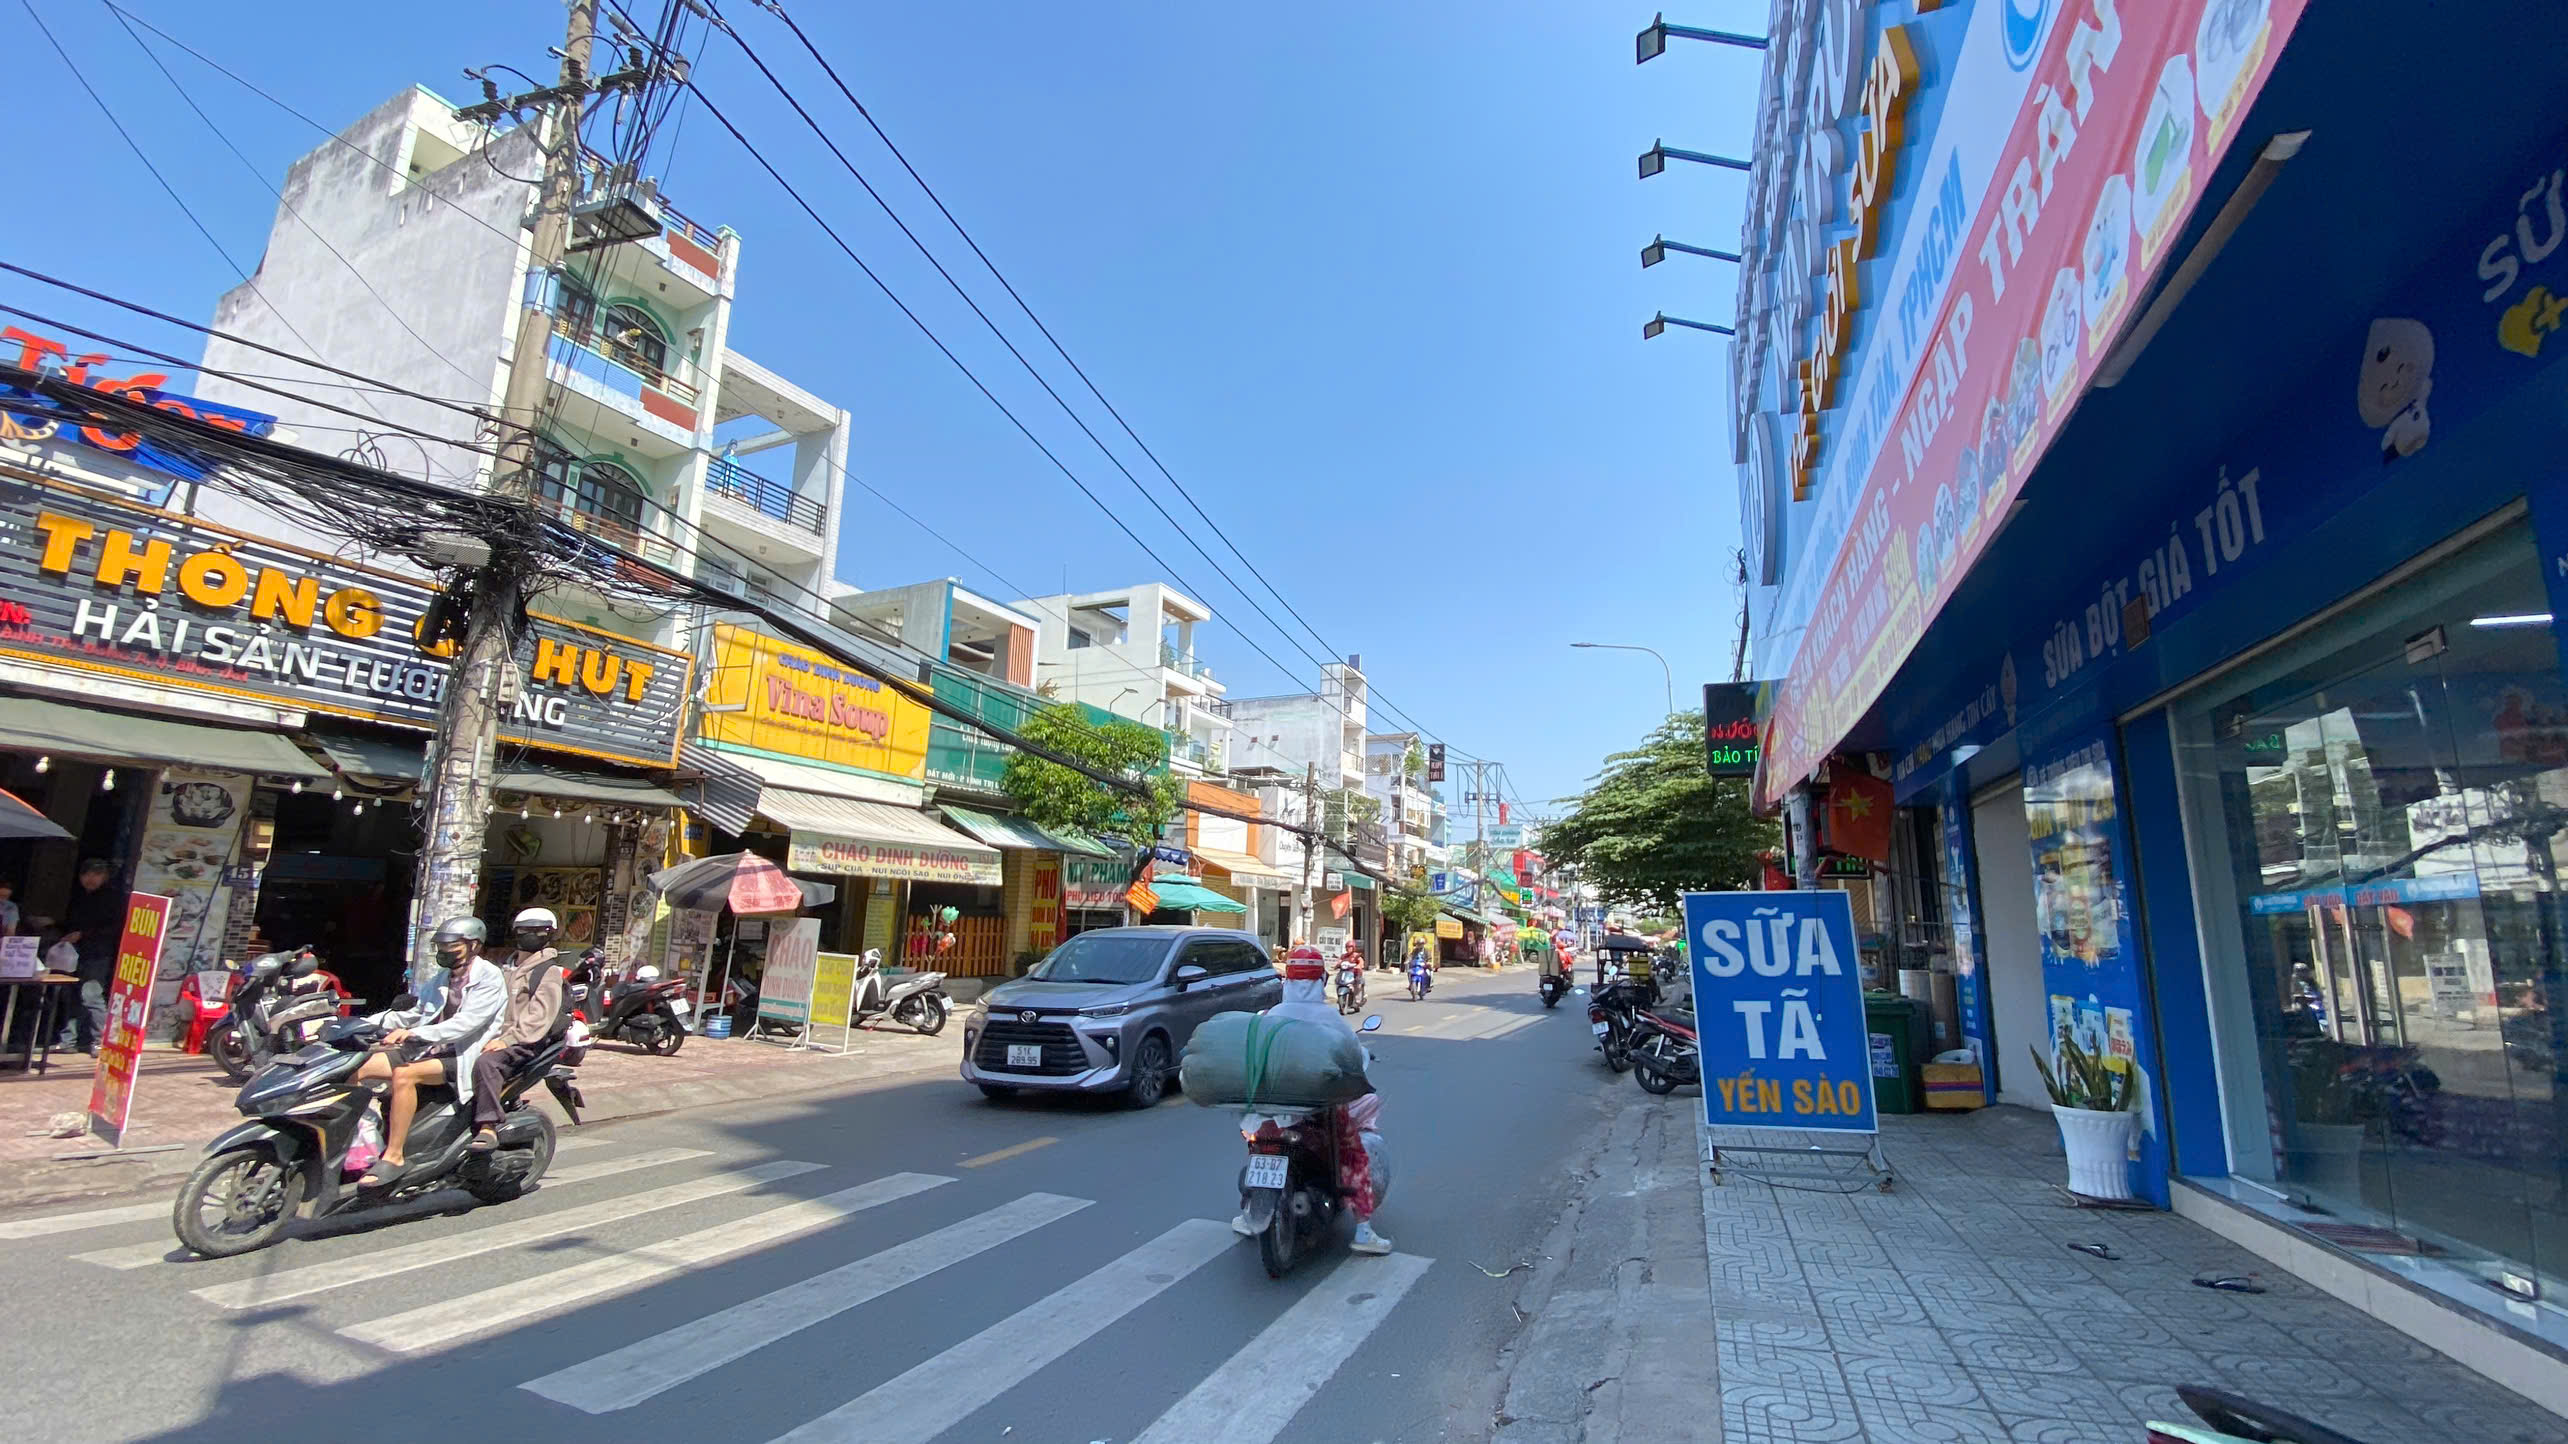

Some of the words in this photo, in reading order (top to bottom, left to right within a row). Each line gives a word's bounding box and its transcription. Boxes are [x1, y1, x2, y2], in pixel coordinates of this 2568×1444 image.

[1899, 145, 1966, 361] TPHCM
[1846, 488, 1890, 598] HÀNG
[1900, 291, 1974, 482] NGẬP
[1979, 0, 2122, 304] TRÀN
[36, 510, 386, 640] THỐNG
[533, 640, 654, 702] HÚT
[2043, 622, 2083, 688] SỮA
[2138, 520, 2192, 620] GIÁ
[2194, 465, 2266, 577] TỐT
[72, 597, 189, 653] HẢI
[200, 624, 323, 680] SẢN
[767, 675, 826, 723] Vina
[829, 693, 888, 741] Soup
[1712, 745, 1741, 764] BẢO
[821, 839, 870, 863] CHÁO
[129, 903, 160, 938] BÚN
[1702, 907, 1842, 978] SỮA
[118, 951, 152, 988] RIÊU
[1734, 987, 1828, 1061] TÃ
[1718, 1068, 1783, 1115] YẾN
